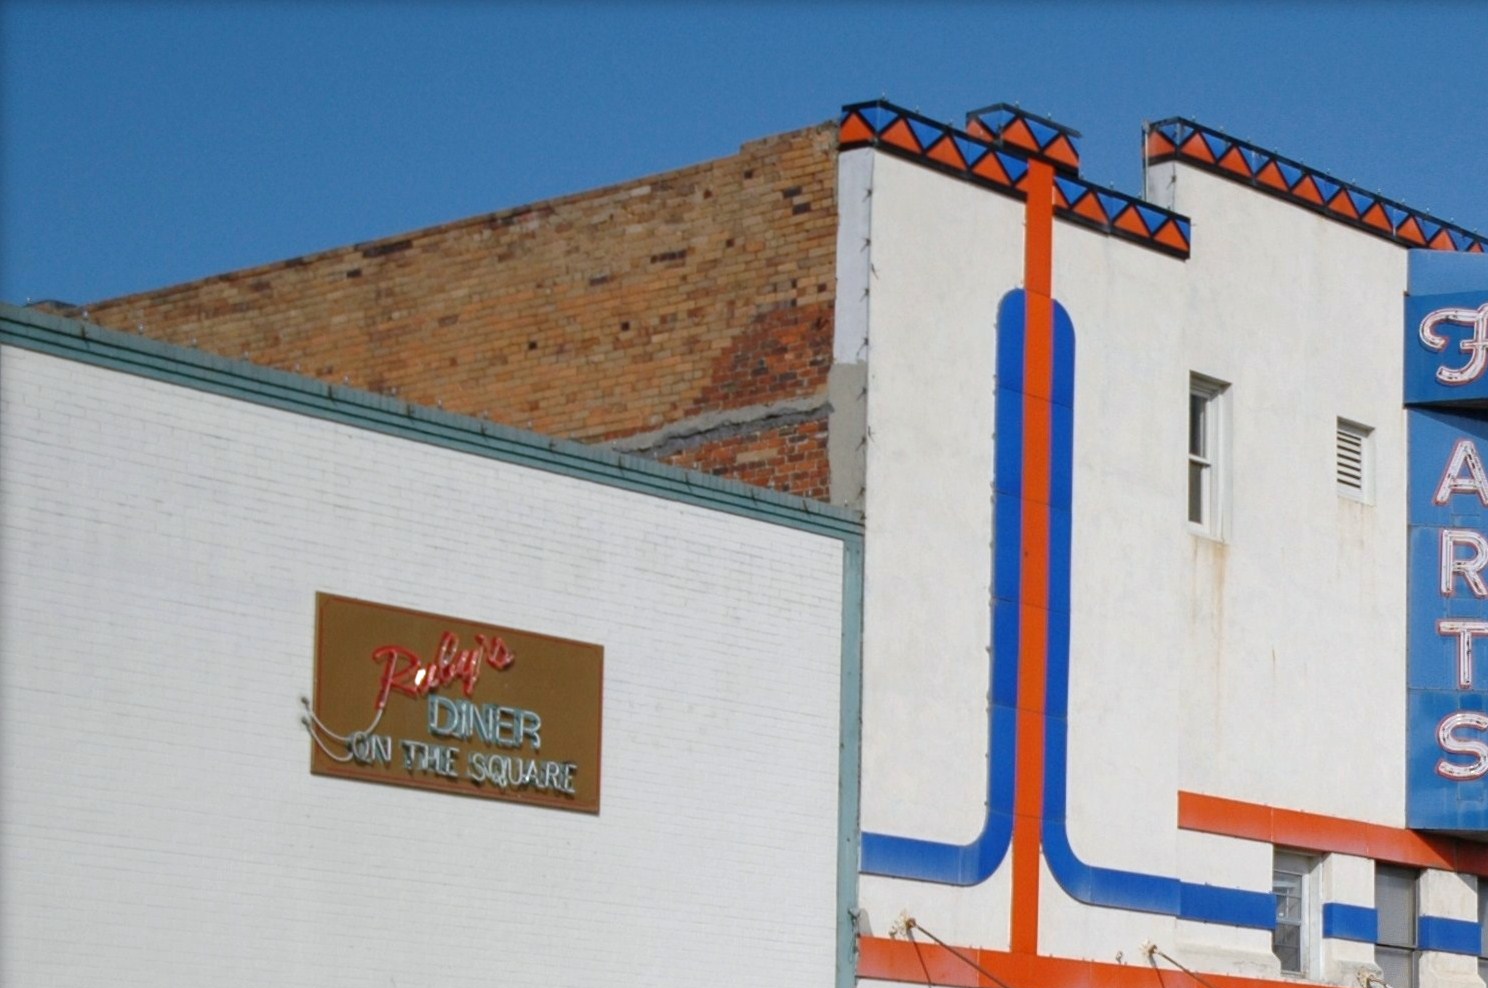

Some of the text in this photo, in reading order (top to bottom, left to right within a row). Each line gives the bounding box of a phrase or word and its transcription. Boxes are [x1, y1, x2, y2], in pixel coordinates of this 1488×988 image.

[373, 632, 514, 710] Ruby's
[427, 692, 543, 751] DINER
[348, 730, 579, 796] ON THE SQUARE
